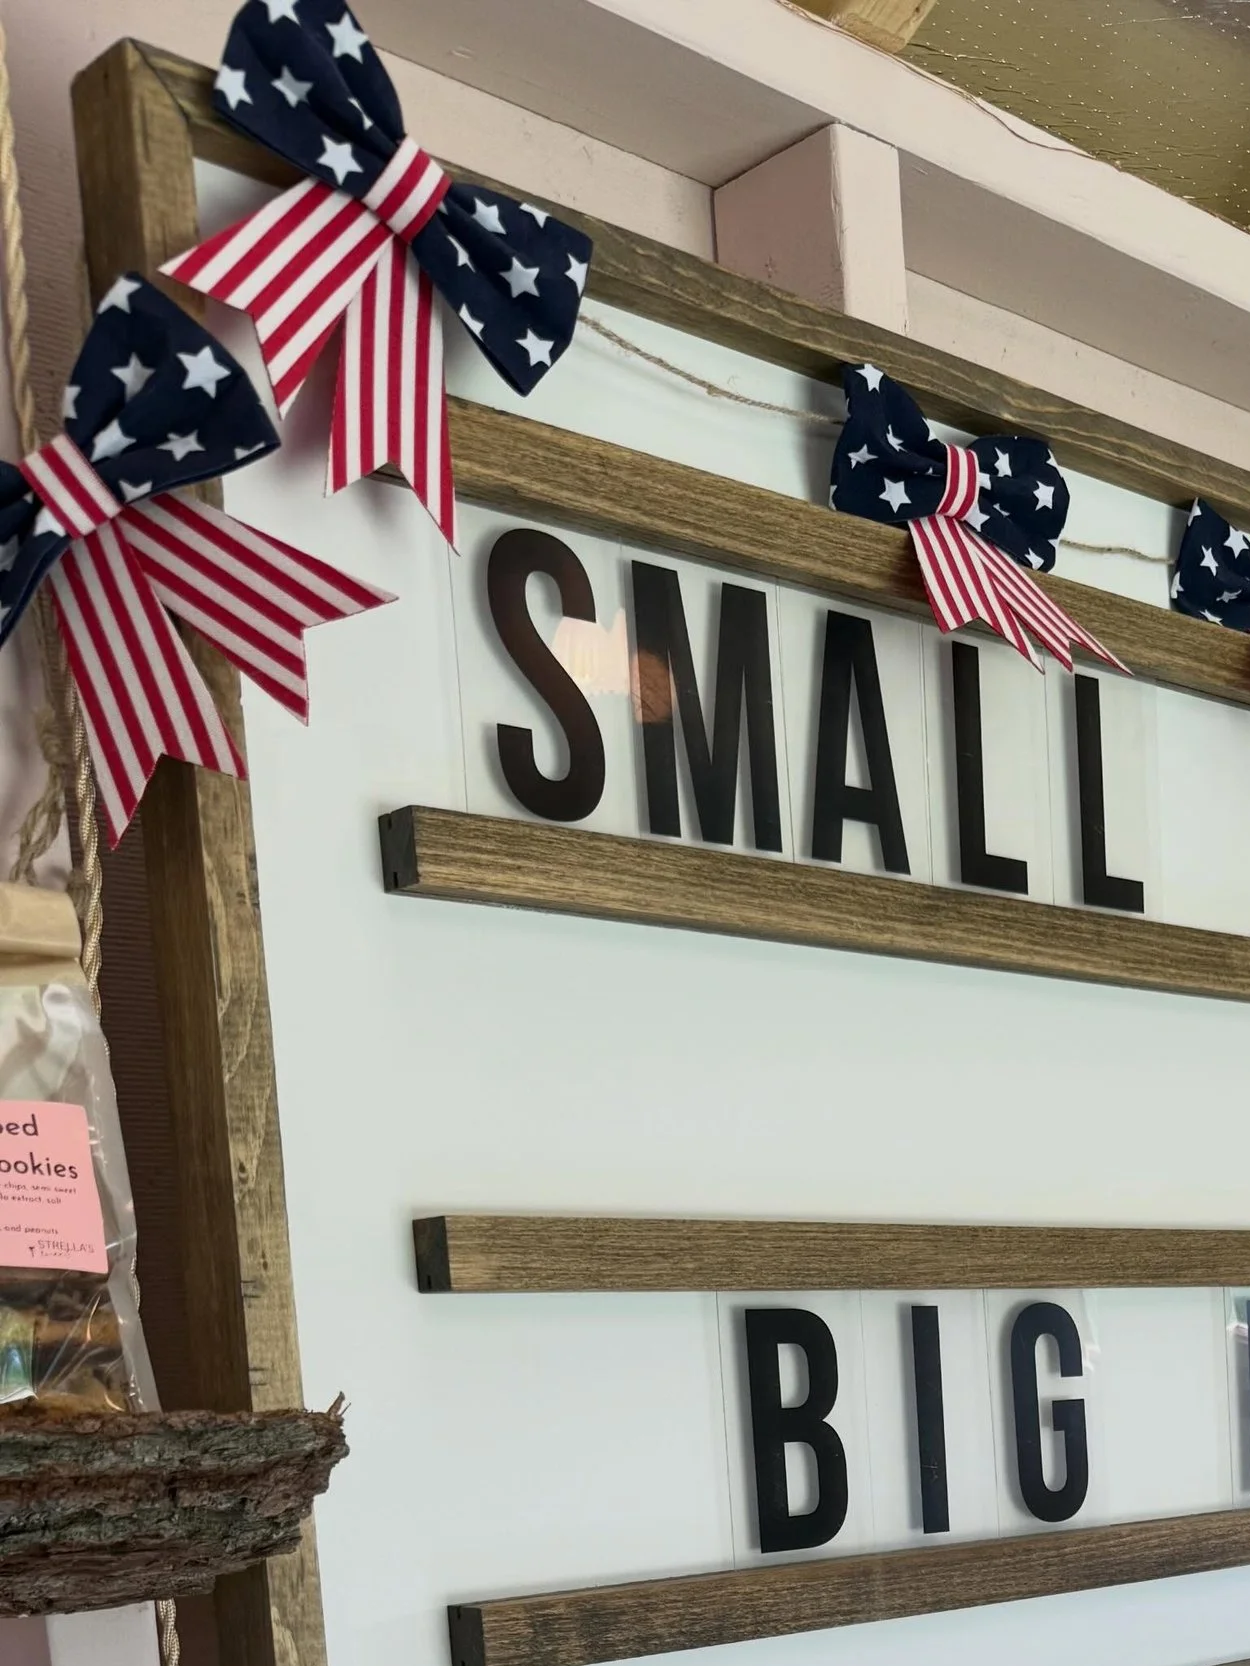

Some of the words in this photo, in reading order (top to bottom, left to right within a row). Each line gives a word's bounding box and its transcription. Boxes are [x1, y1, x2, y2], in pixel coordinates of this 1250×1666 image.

[487, 528, 1145, 913] SMALL
[0, 1113, 38, 1136] ed
[744, 1302, 1089, 1554] BIG
